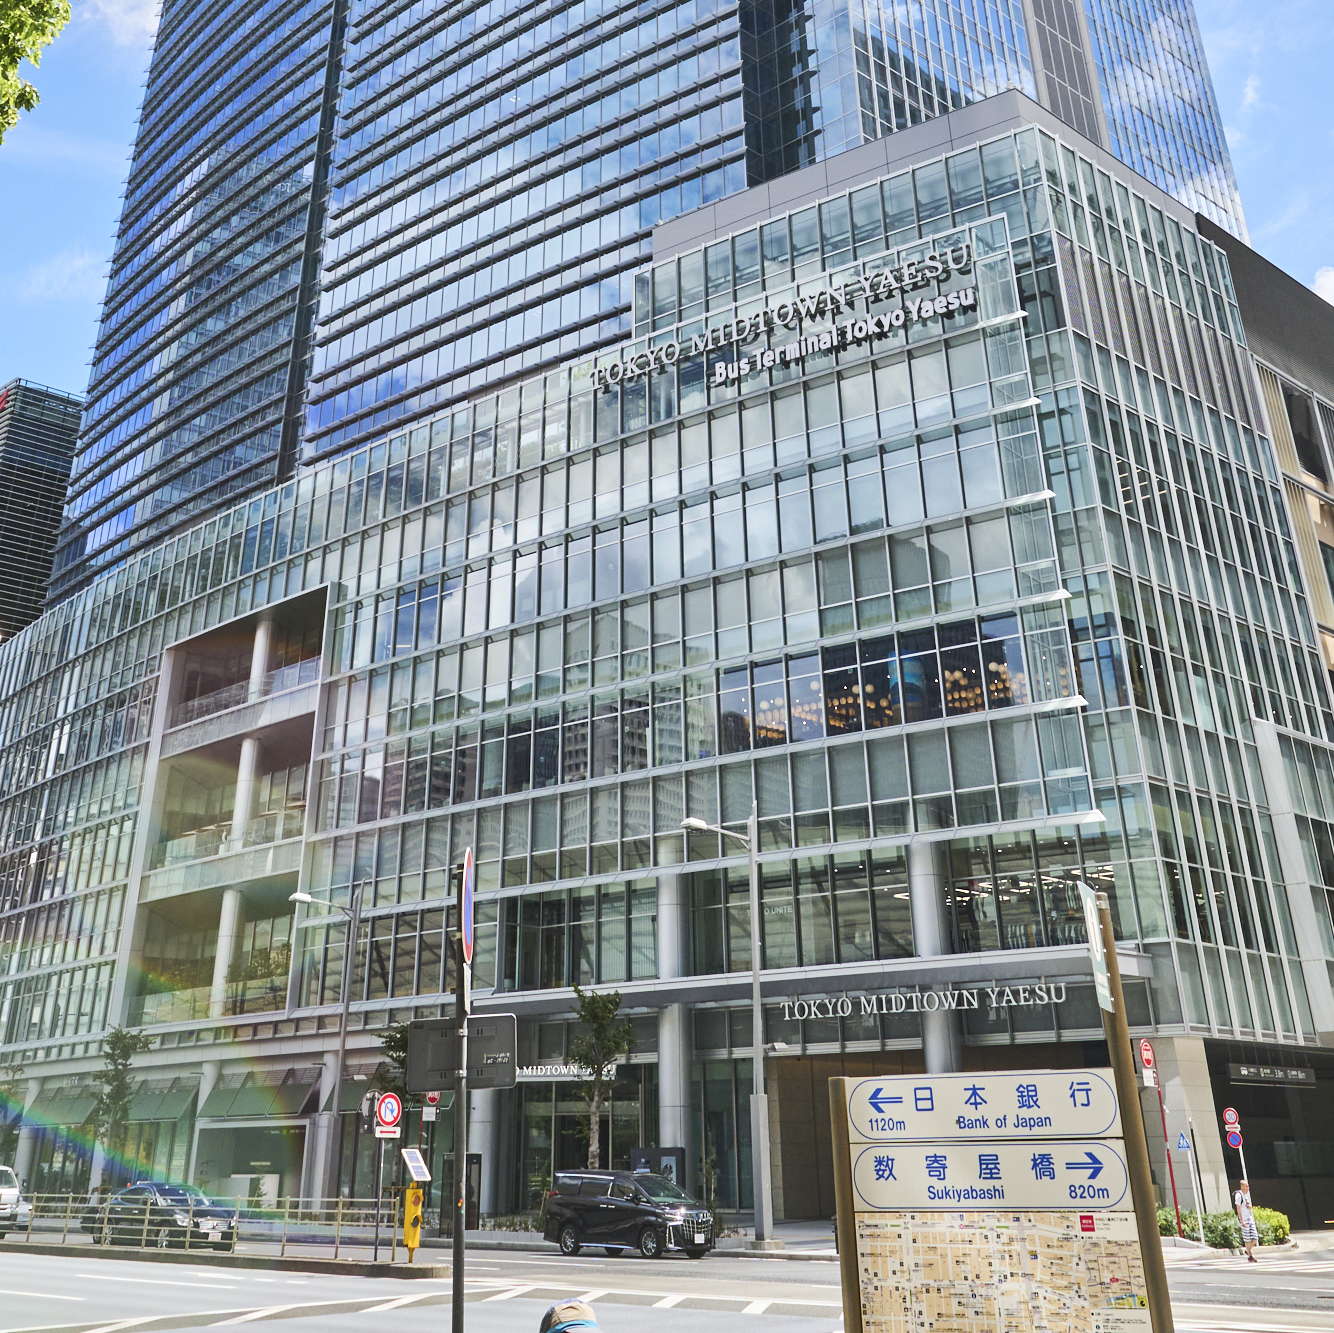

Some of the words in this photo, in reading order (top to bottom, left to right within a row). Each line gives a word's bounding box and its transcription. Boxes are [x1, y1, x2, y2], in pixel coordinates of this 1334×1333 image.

[589, 341, 680, 389] TOKYO
[690, 283, 851, 357] MIDTOWN
[858, 243, 972, 298] YAESU
[715, 357, 751, 384] Bus
[752, 325, 838, 370] Terminal
[842, 309, 905, 343] Tokyo
[905, 288, 975, 323] Yaesu
[771, 905, 793, 914] UNITE
[780, 997, 852, 1020] TOKYO
[860, 990, 979, 1015] MIDTOWN
[985, 983, 1066, 1007] YAESU
[523, 1065, 578, 1076] MIDTOWN
[913, 1081, 1092, 1112] 日本銀行
[868, 1118, 906, 1131] 1120m
[958, 1115, 989, 1129] Bank
[995, 1114, 1007, 1128] of
[1013, 1114, 1052, 1131] Japan
[873, 1152, 1055, 1181] 数寄屋橋
[927, 1185, 1005, 1202] Sukiyabashi
[1068, 1184, 1110, 1199] 820m
